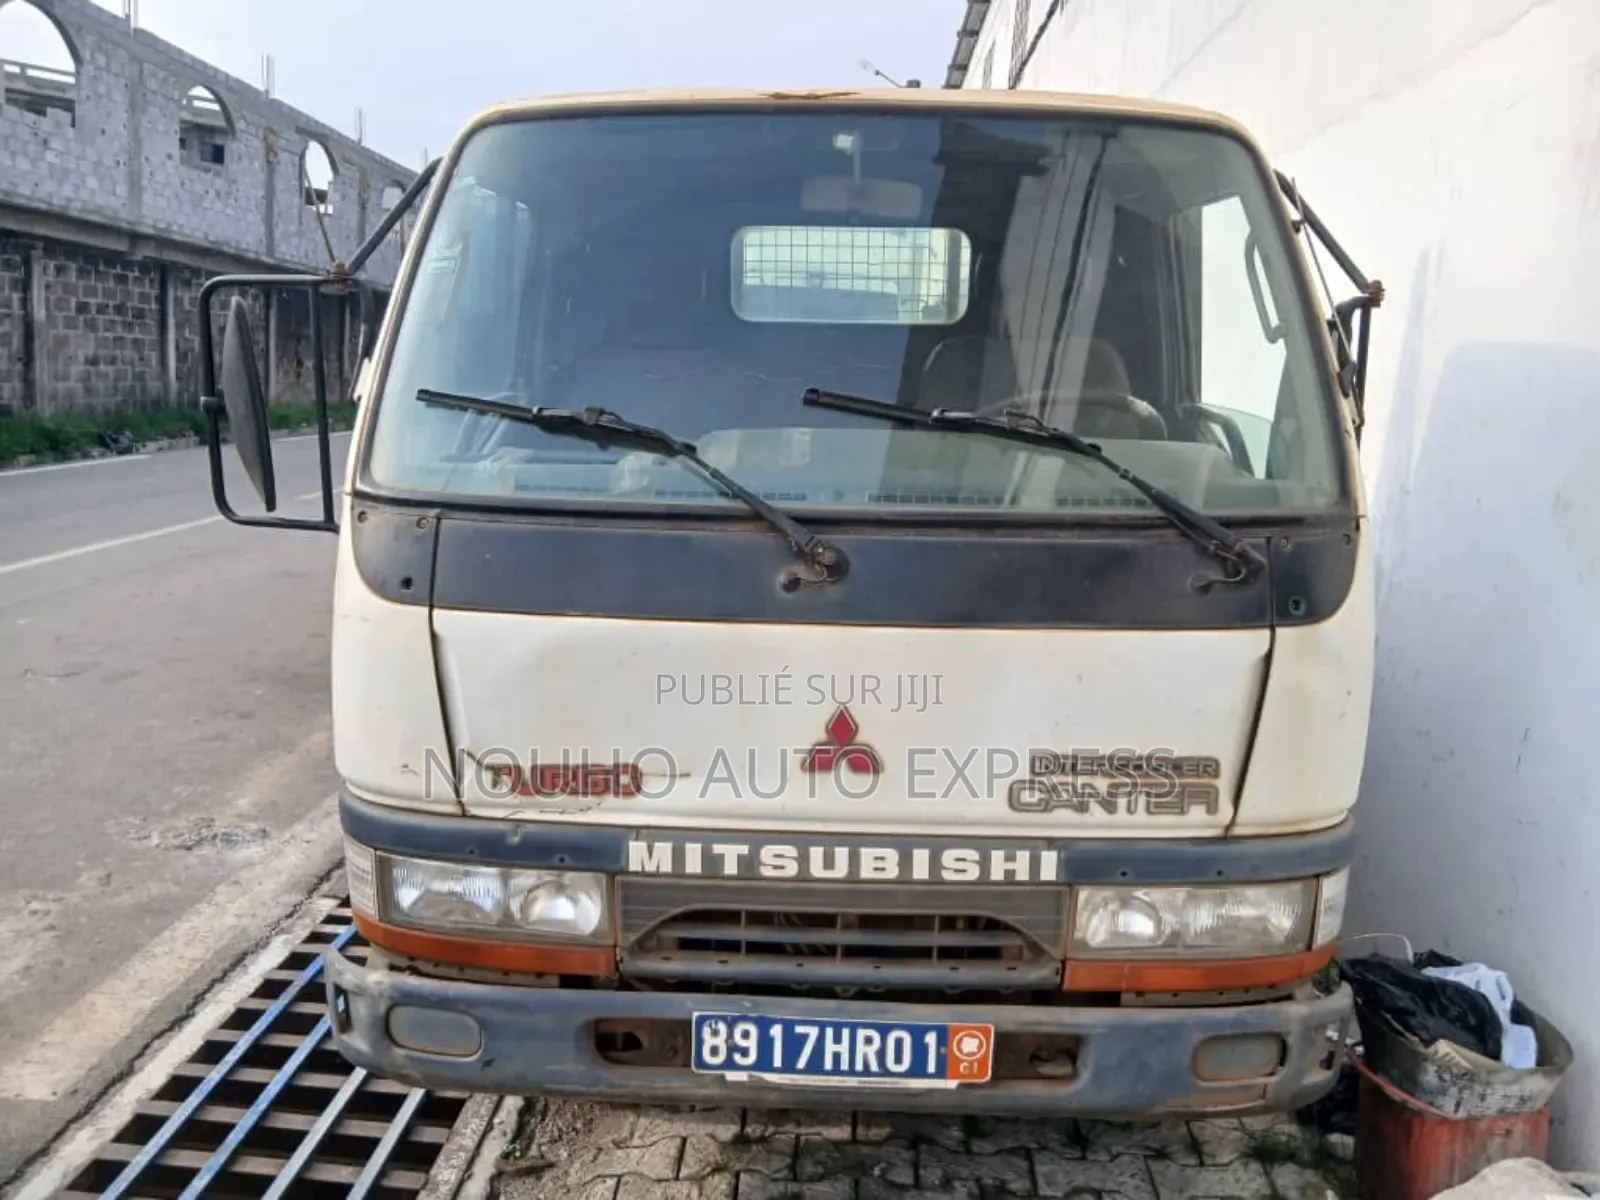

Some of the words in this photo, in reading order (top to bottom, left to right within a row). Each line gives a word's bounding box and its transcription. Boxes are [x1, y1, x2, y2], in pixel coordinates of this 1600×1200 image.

[1008, 779, 1220, 815] CANTER
[628, 840, 1058, 882] MITSUBISHI
[701, 1019, 938, 1075] 8917HR01
